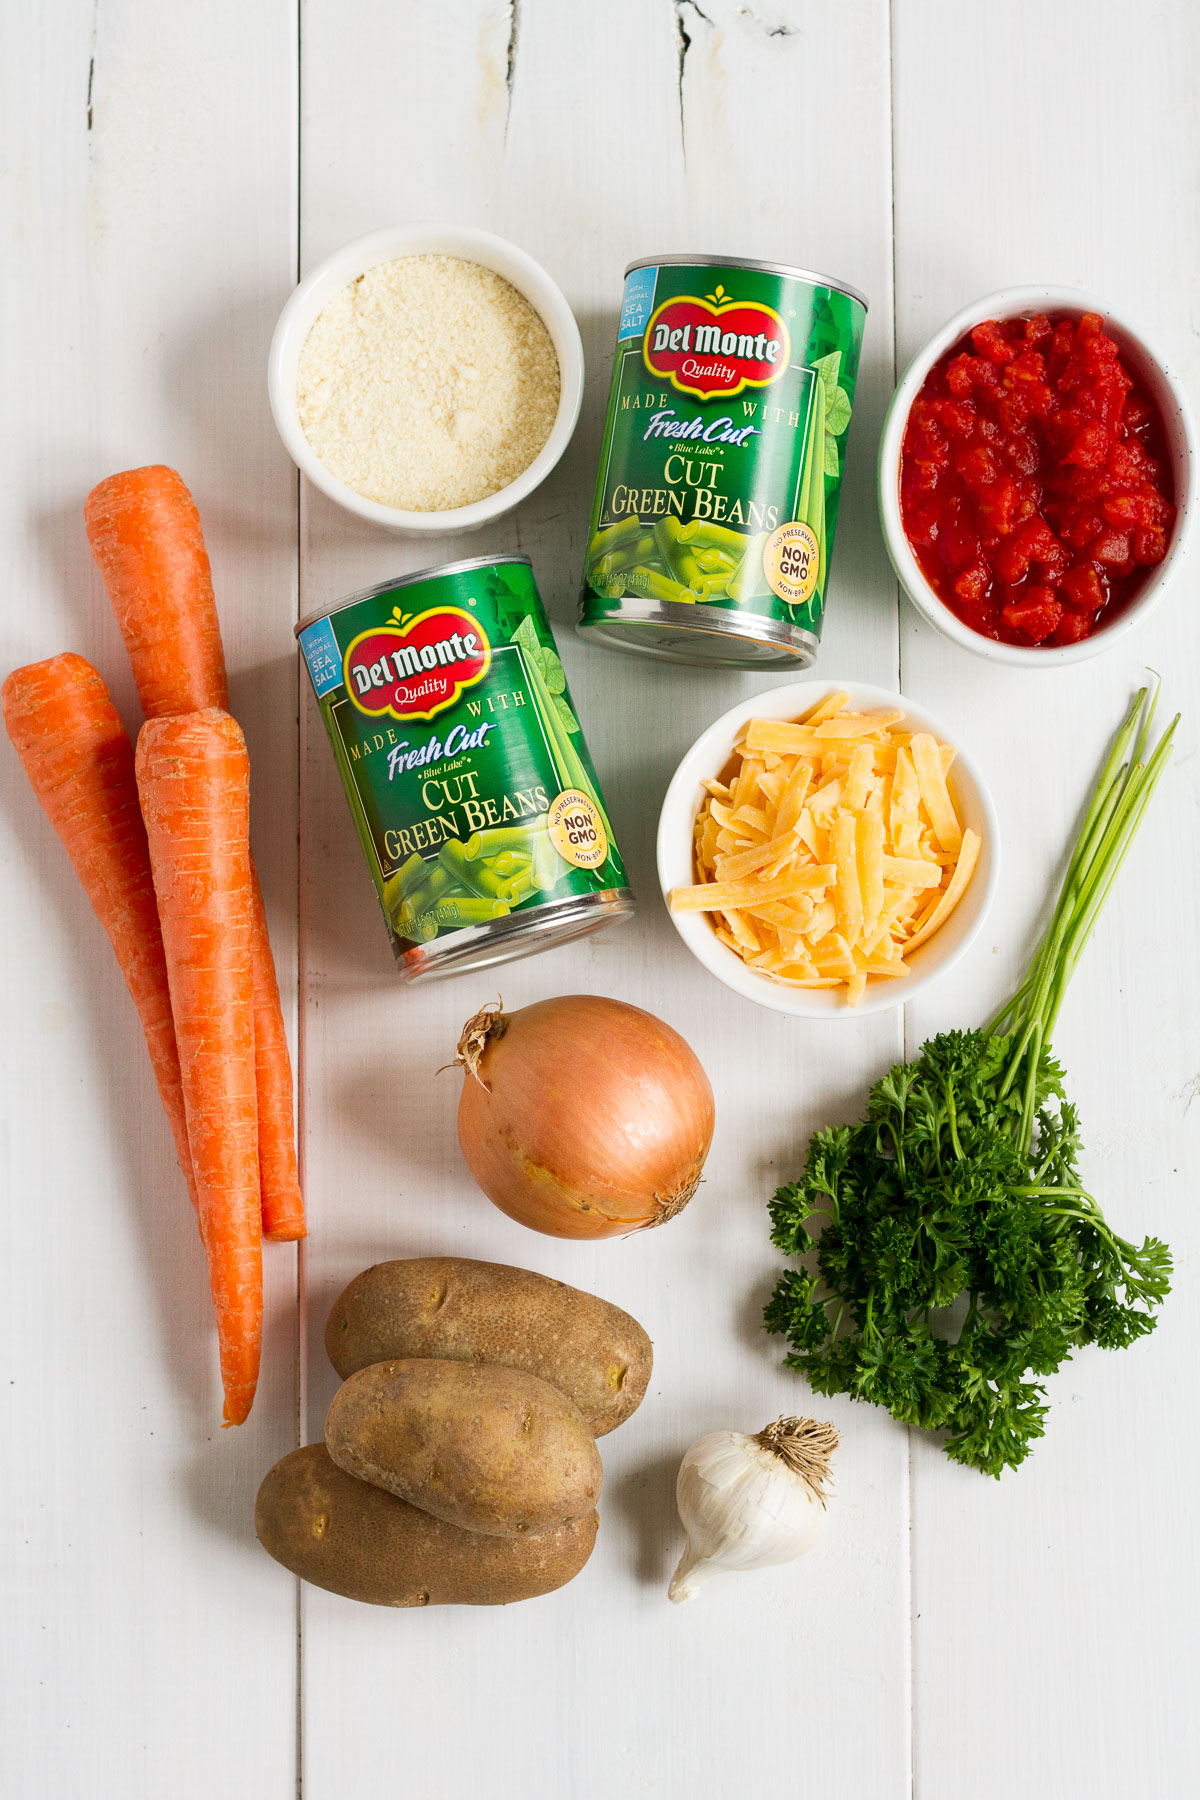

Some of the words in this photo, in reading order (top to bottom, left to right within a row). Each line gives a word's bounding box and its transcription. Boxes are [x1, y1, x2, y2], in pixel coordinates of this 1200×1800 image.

[625, 303, 642, 316] SEA
[622, 315, 644, 330] SALT
[654, 323, 690, 352] Del
[695, 325, 781, 363] Monte
[682, 359, 736, 382] Quality
[621, 393, 668, 410] MADE
[742, 401, 800, 428] WITH
[643, 410, 703, 442] Fresh
[674, 443, 694, 453] Blue
[664, 454, 724, 489] CUT
[612, 485, 686, 516] GREEN
[692, 488, 779, 530] BEANS
[773, 537, 783, 549] NO
[782, 528, 816, 560] PRESERVATIVES
[782, 545, 810, 566] NON
[628, 573, 650, 590] (411g)
[780, 561, 808, 580] GMO
[308, 636, 322, 648] WITH
[312, 654, 332, 672] SEA
[352, 660, 394, 694] Del
[391, 632, 480, 678] Monte
[315, 664, 336, 686] SALT
[394, 678, 447, 705] Quality
[350, 728, 398, 762] MADE
[466, 690, 526, 718] WITH
[387, 736, 444, 781] Fresh
[424, 767, 442, 779] Blue
[422, 771, 480, 810] CUT
[384, 812, 461, 860] GREEN
[460, 786, 550, 832] BEANS
[554, 812, 561, 826] NO
[564, 814, 593, 830] NON
[568, 828, 597, 844] GMO
[426, 910, 438, 925] OZ
[436, 902, 460, 923] (411g)
